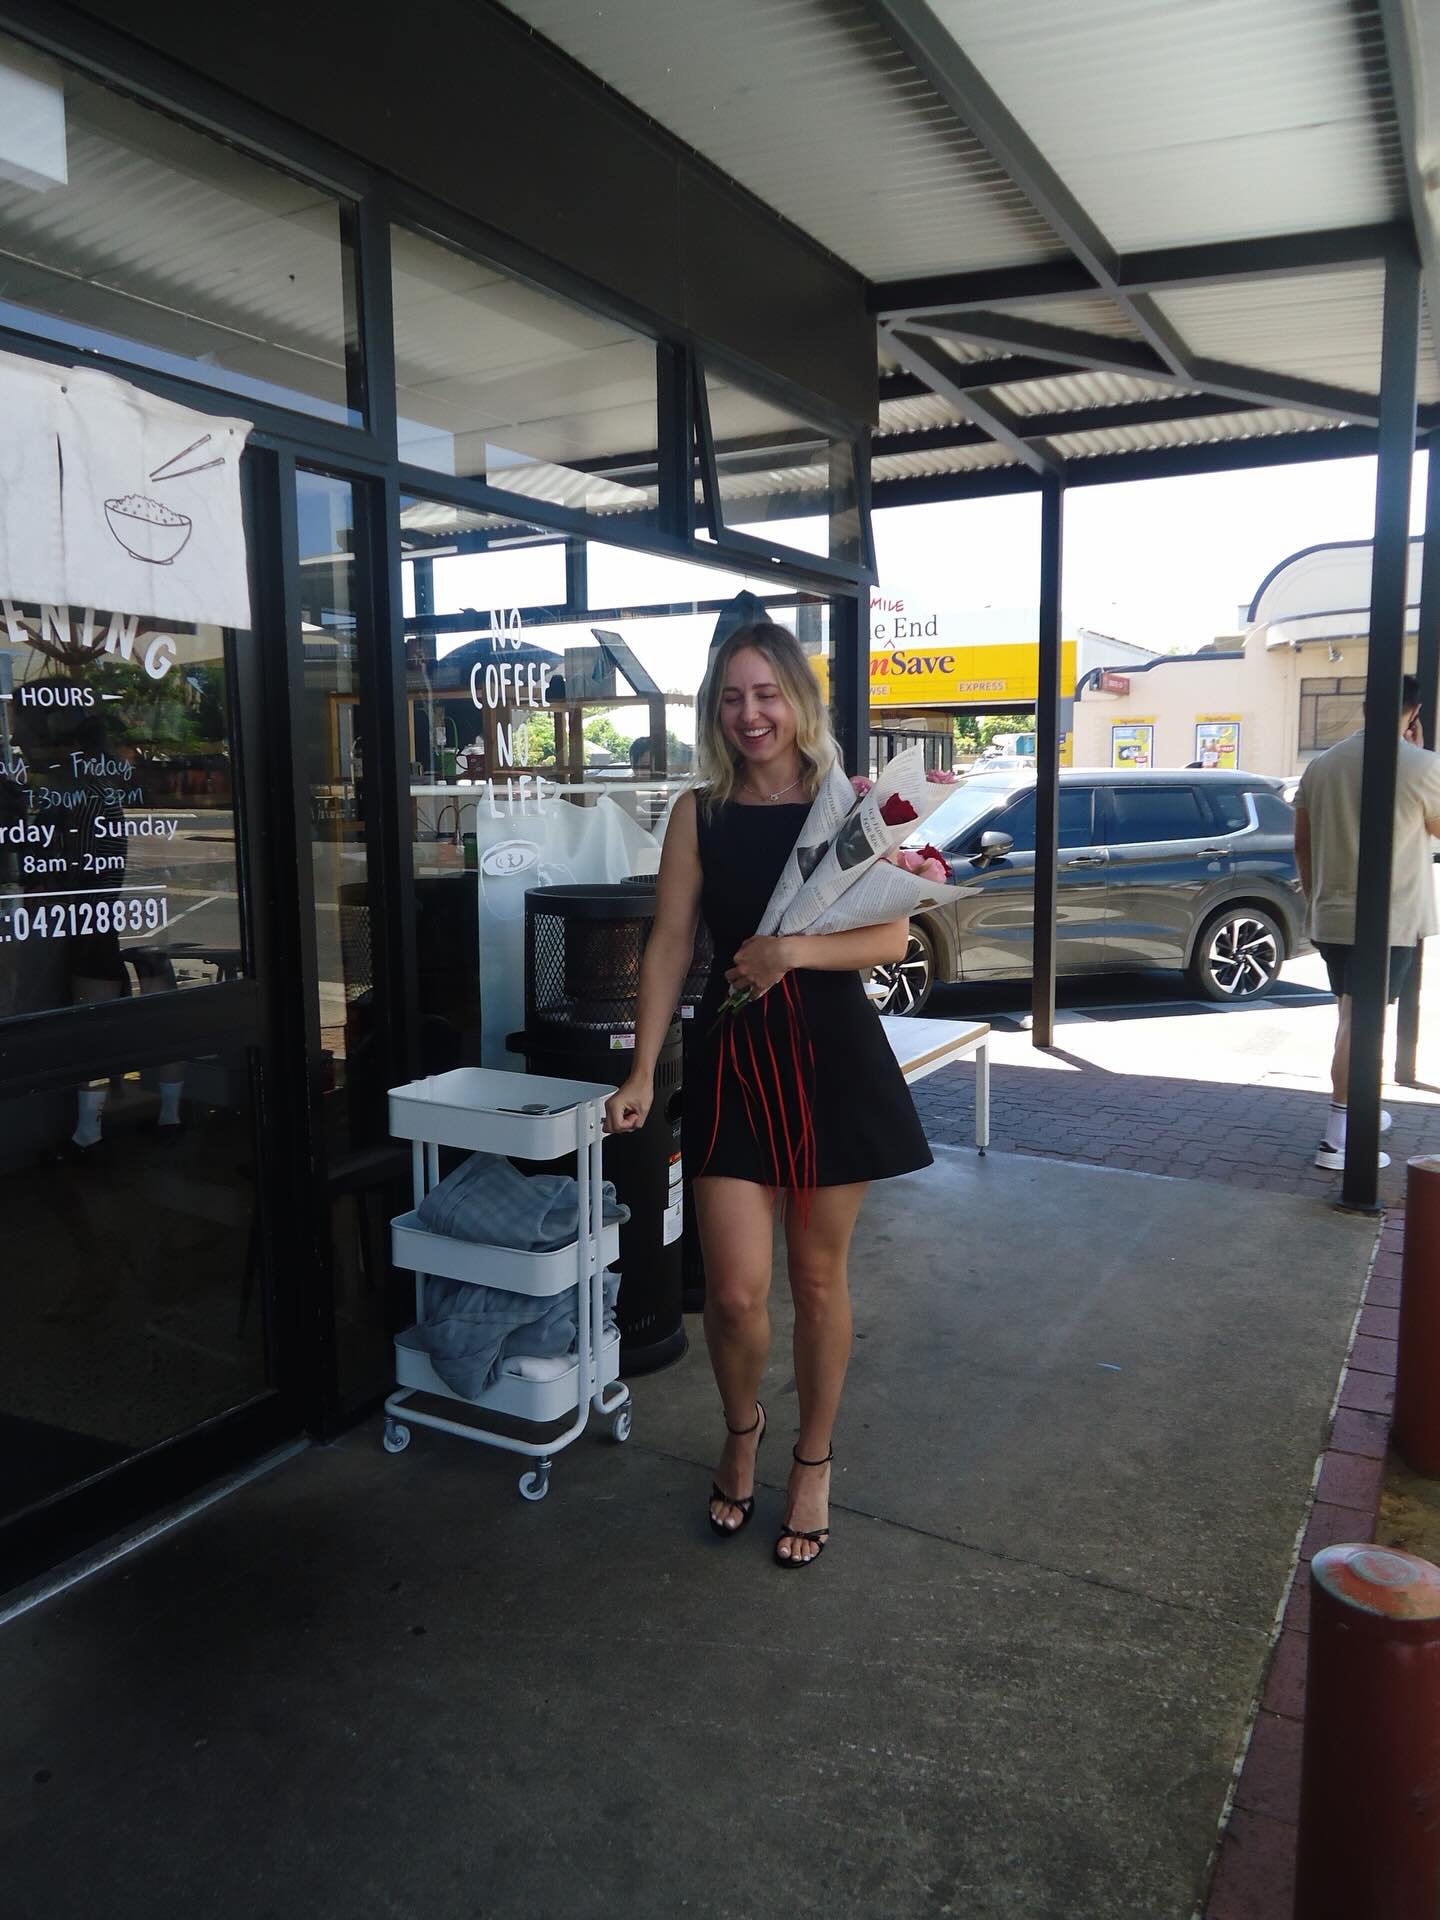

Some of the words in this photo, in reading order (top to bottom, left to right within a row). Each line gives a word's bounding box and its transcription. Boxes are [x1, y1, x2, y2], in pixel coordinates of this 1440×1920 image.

[490, 608, 522, 651] NO
[894, 614, 938, 638] End
[20, 686, 95, 707] HOURS
[470, 662, 551, 710] COFFEE
[959, 681, 1004, 693] EXPRESS
[496, 722, 529, 767] NO
[70, 751, 137, 781] Friday
[488, 776, 547, 819] LIFE
[94, 814, 179, 840] Sunday
[24, 855, 67, 874] 8am
[83, 853, 125, 879] 2pm
